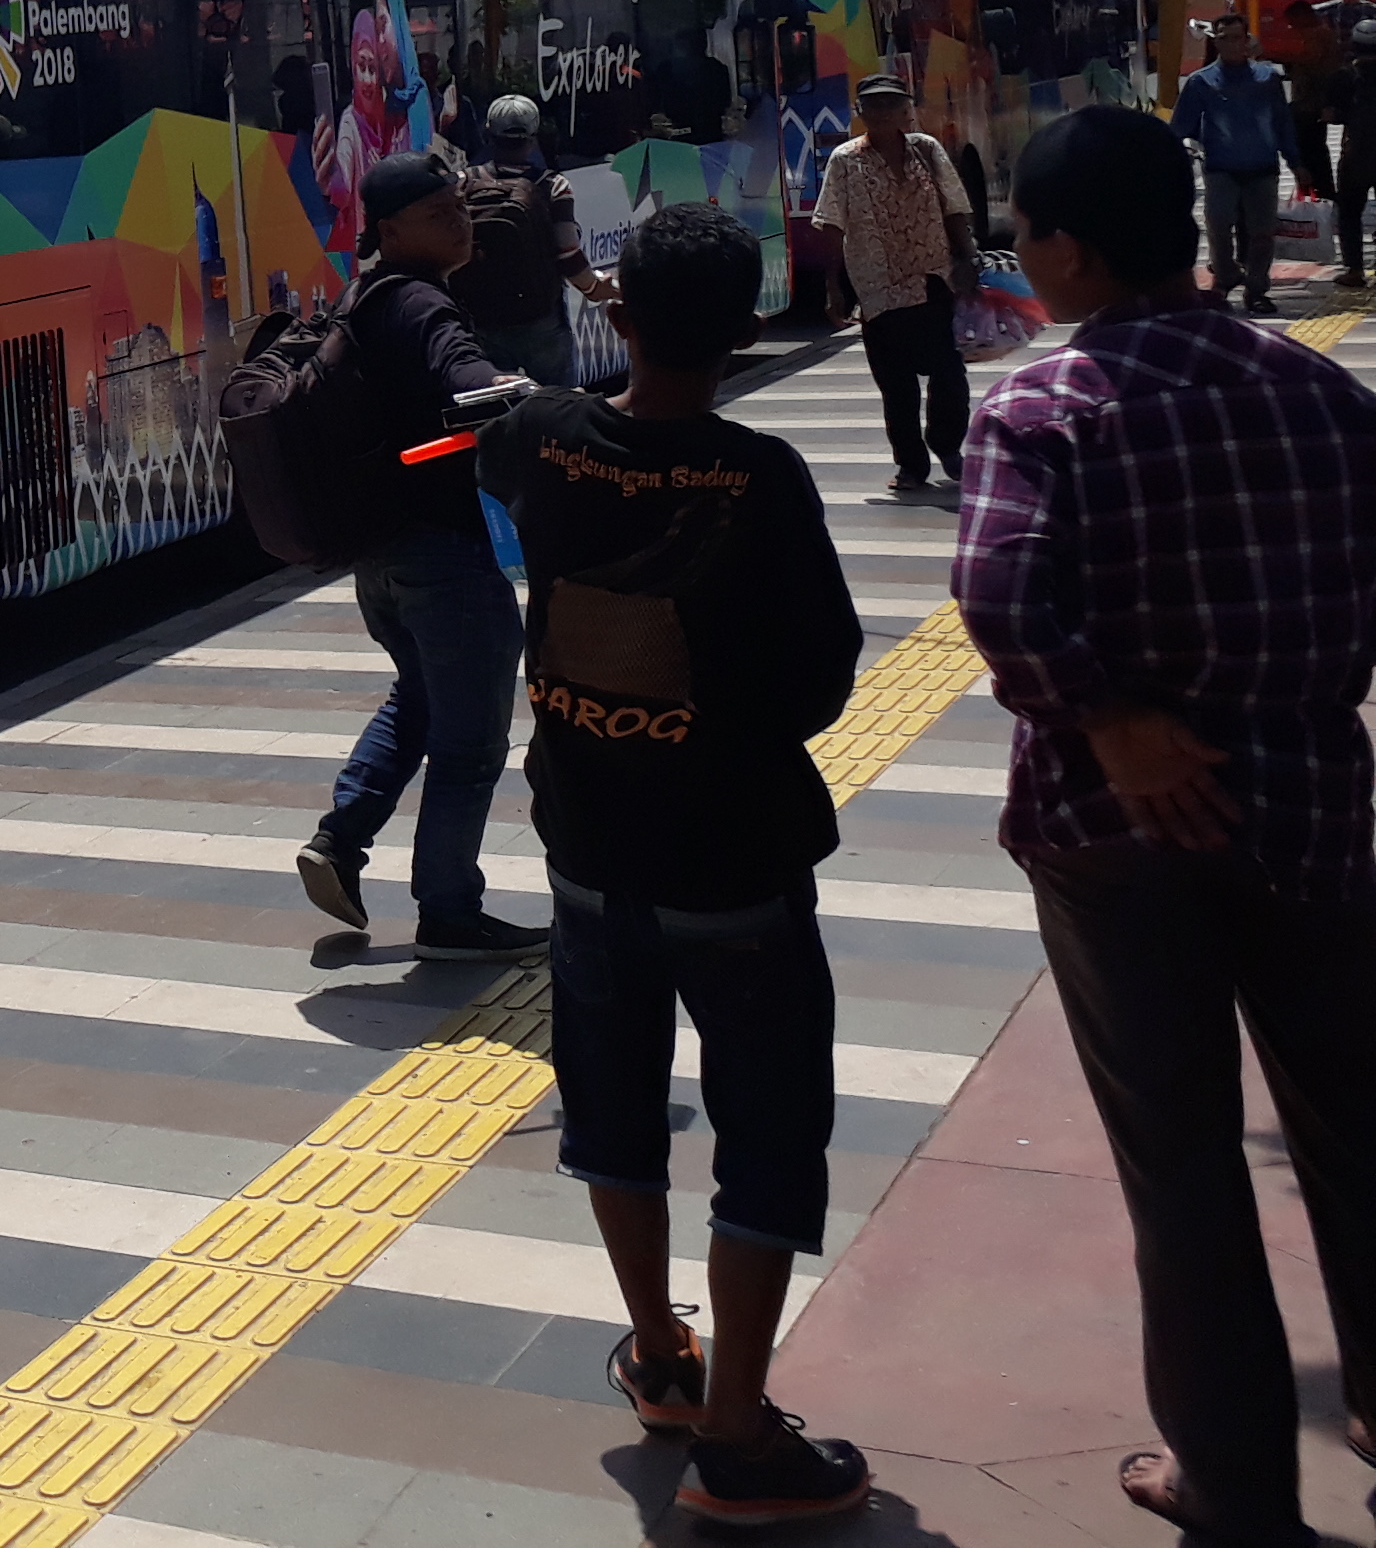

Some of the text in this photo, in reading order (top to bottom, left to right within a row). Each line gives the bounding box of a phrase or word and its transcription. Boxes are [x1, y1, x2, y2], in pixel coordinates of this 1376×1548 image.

[31, 45, 76, 88] 2018
[537, 12, 641, 138] Explorer
[670, 458, 752, 497] Baduy
